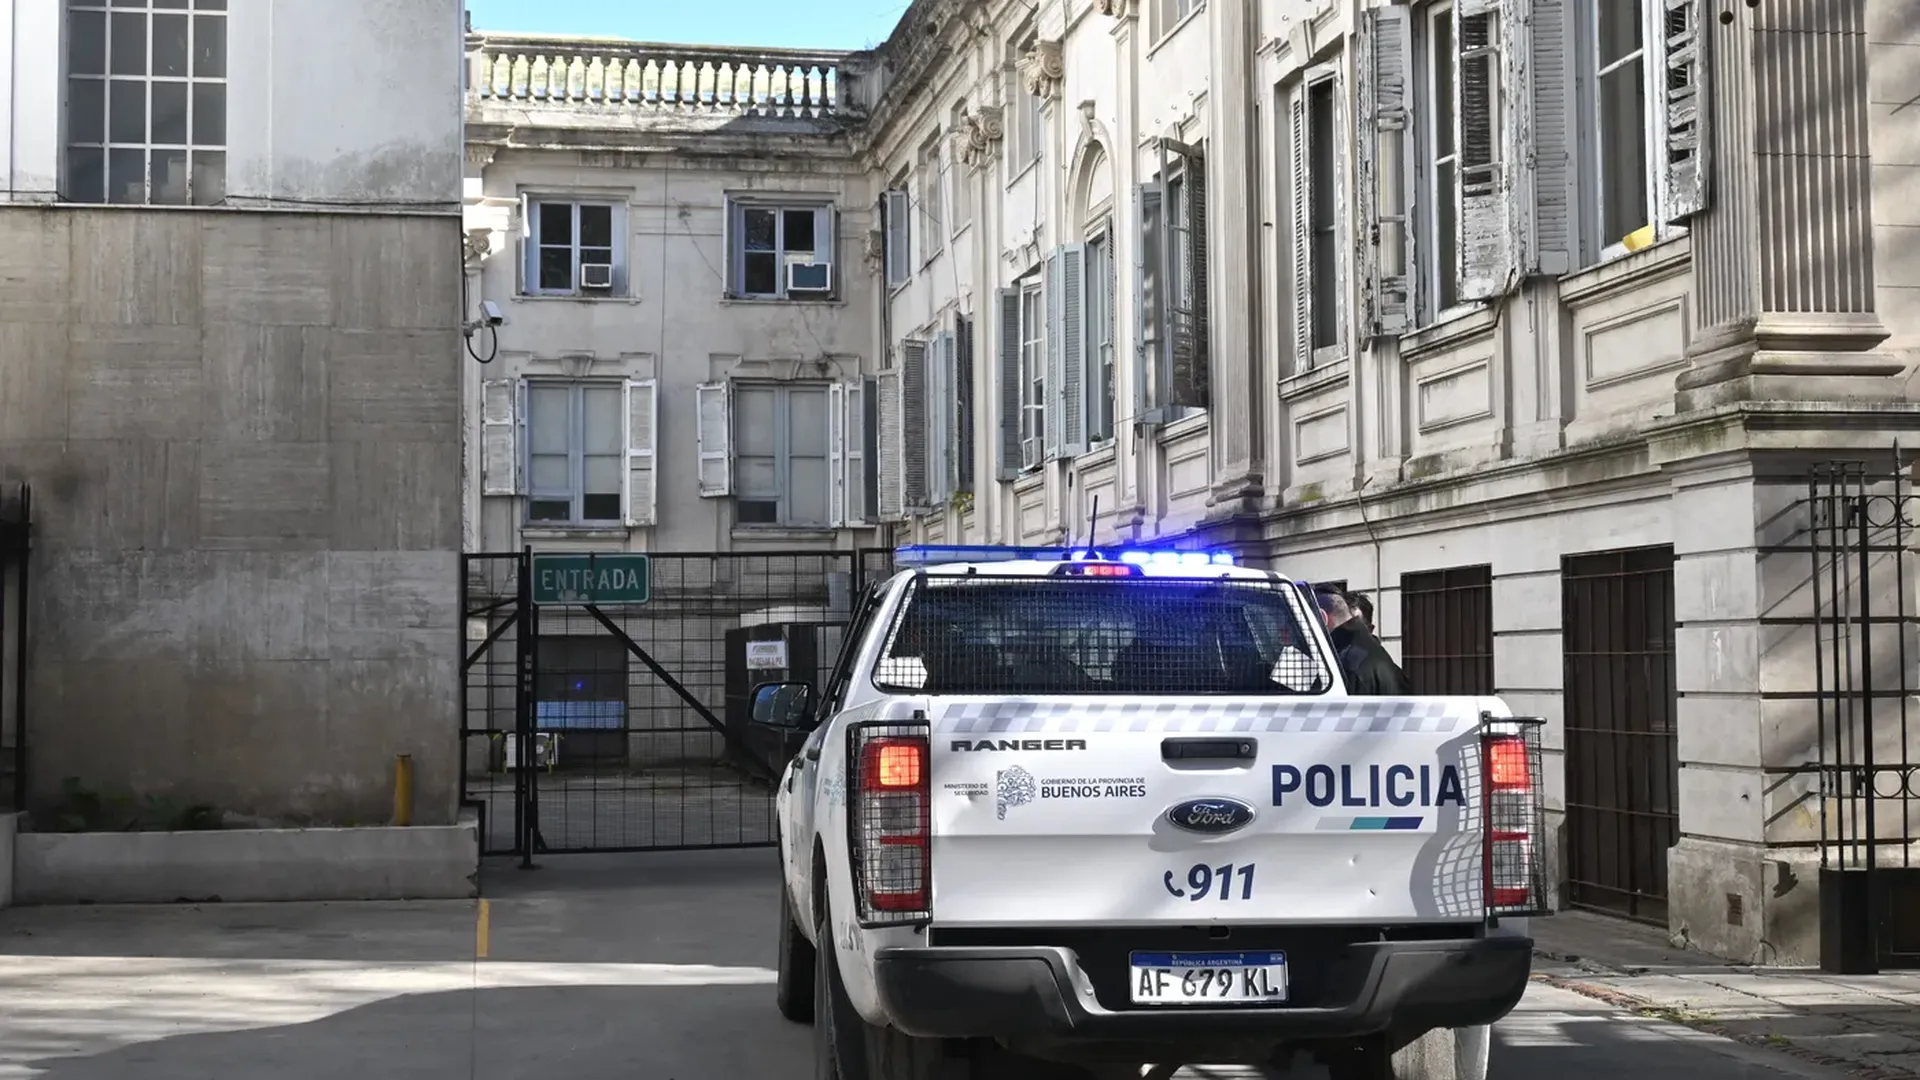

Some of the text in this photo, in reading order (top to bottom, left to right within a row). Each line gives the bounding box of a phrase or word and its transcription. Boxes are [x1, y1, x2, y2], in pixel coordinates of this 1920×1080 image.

[541, 568, 639, 590] ENTRADA
[951, 739, 1087, 751] RANGER
[1041, 785, 1146, 798] BUENOS AIRES
[1271, 764, 1466, 807] POLICIA
[1186, 803, 1235, 826] Ford
[1187, 863, 1256, 901] 911
[1207, 958, 1243, 966] ARGENTINA
[1139, 968, 1279, 997] AF 679 KL
